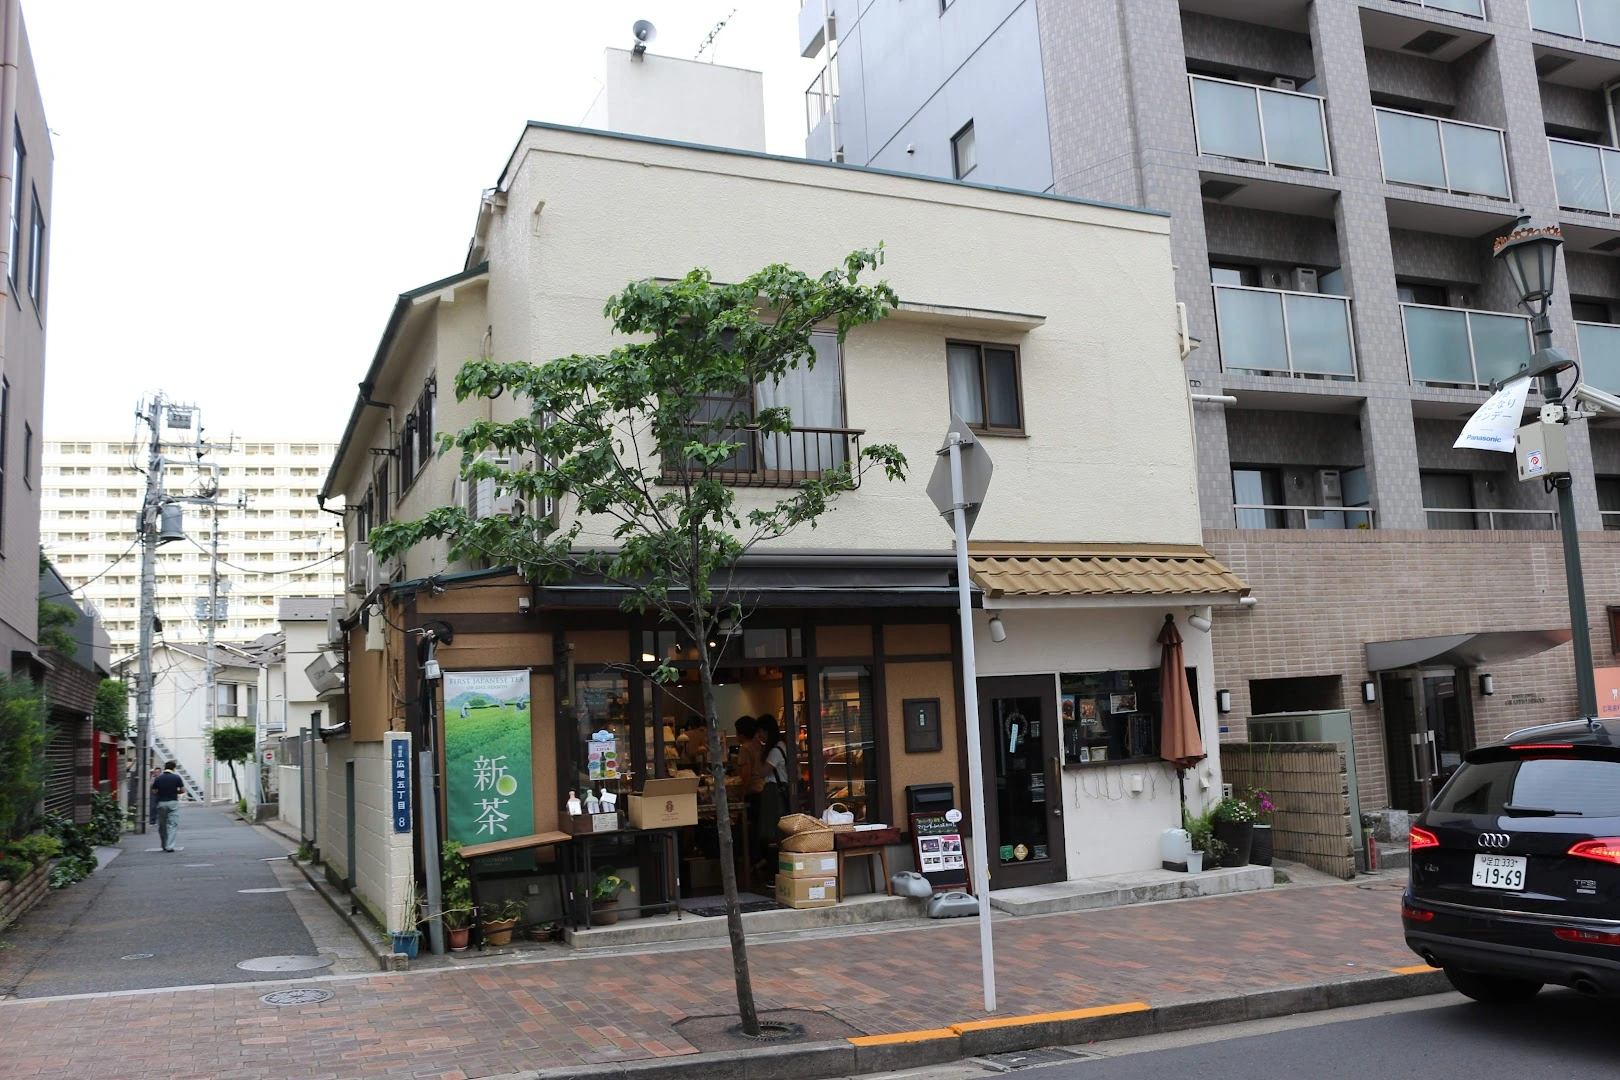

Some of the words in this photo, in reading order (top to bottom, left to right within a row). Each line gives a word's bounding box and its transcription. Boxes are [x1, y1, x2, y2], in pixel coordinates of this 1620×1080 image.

[1466, 434, 1502, 443] Panasonic
[472, 755, 511, 835] 新茶
[398, 817, 406, 827] 8
[1501, 858, 1515, 867] 333
[1485, 867, 1522, 887] 19-69
